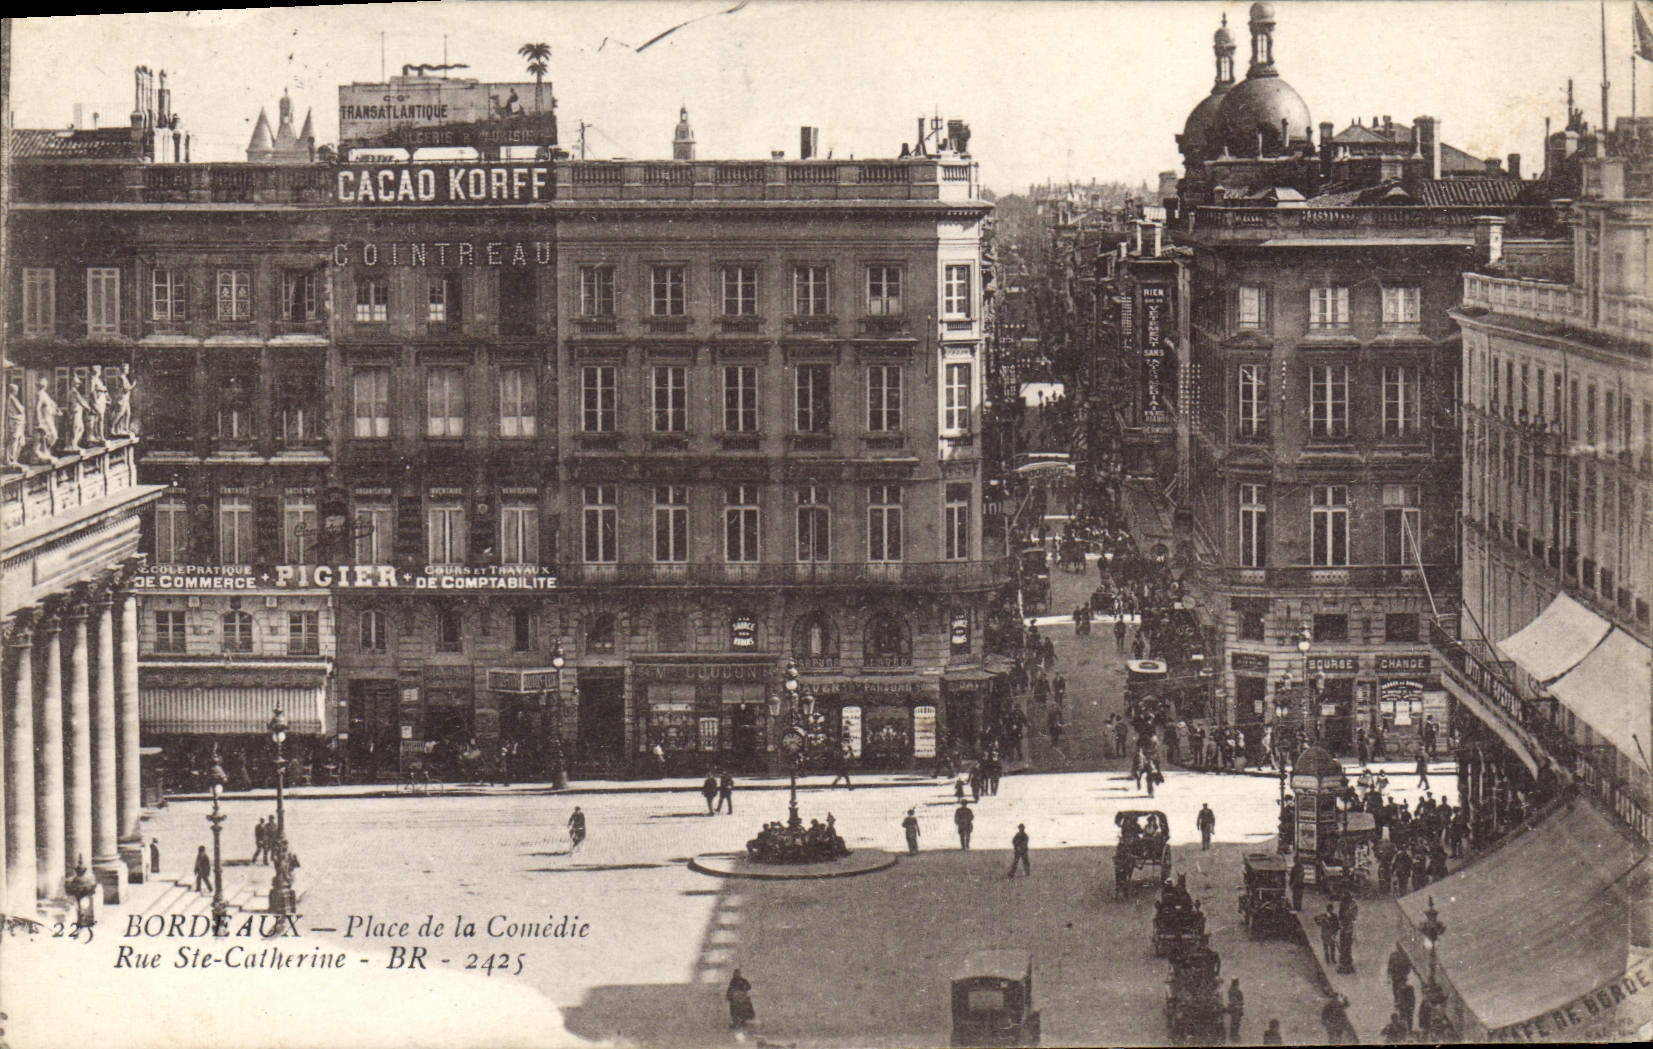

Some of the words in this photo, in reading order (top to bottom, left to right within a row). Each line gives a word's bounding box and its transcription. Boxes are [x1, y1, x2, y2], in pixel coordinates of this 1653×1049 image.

[340, 104, 448, 120] TRANSATLANTIQUE
[337, 168, 436, 202] CACAO
[448, 167, 548, 201] KORFF
[334, 242, 550, 266] COINTREAU
[186, 564, 253, 575] PRATIQUE
[424, 565, 471, 575] COURS
[473, 567, 486, 575] ET
[489, 565, 550, 575] TRAVAUX
[159, 575, 256, 588] COMMERCE
[275, 565, 399, 588] PIGIER
[415, 576, 438, 589] DE
[441, 576, 557, 589] COMPTABILITE
[1309, 659, 1353, 669] BOURSE
[1381, 658, 1425, 669] CHANGE
[1552, 1009, 1581, 1031] DE
